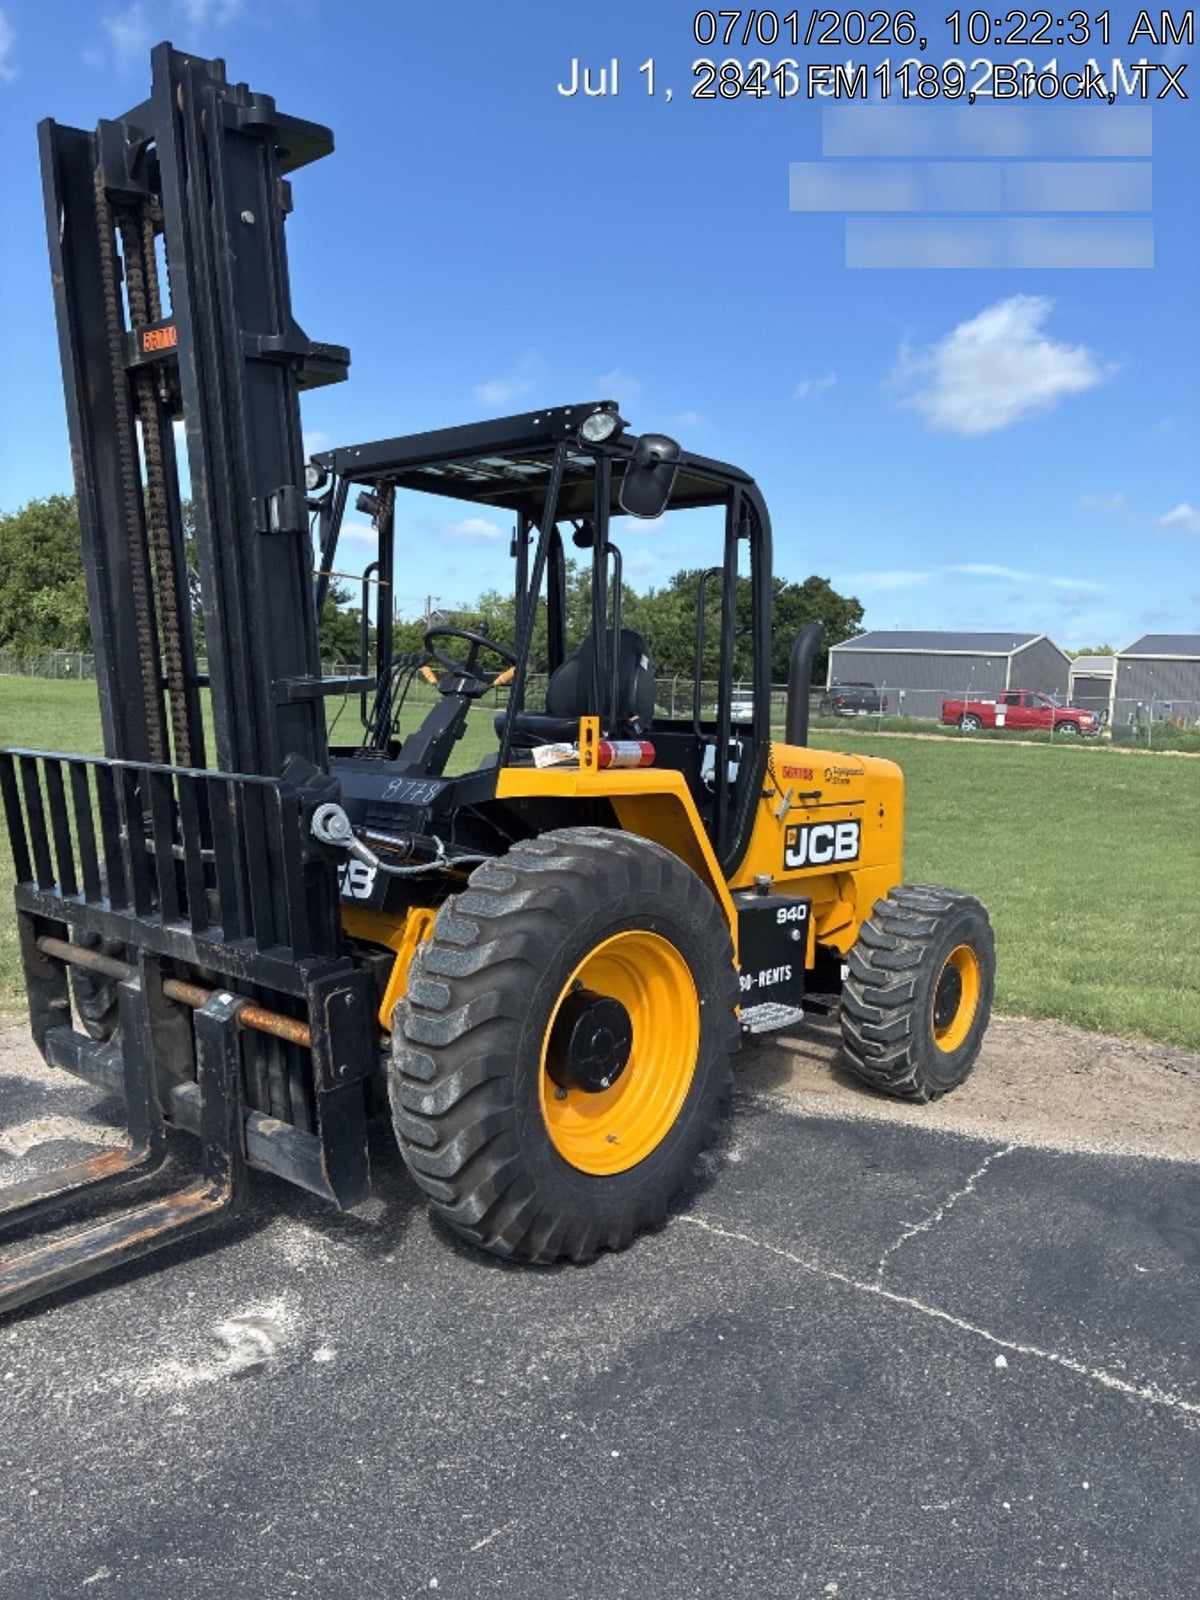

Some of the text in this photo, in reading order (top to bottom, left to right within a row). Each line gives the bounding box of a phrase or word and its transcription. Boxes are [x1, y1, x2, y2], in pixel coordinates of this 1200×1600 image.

[382, 778, 441, 803] 8778
[785, 822, 859, 867] JCB
[776, 904, 807, 924] 940
